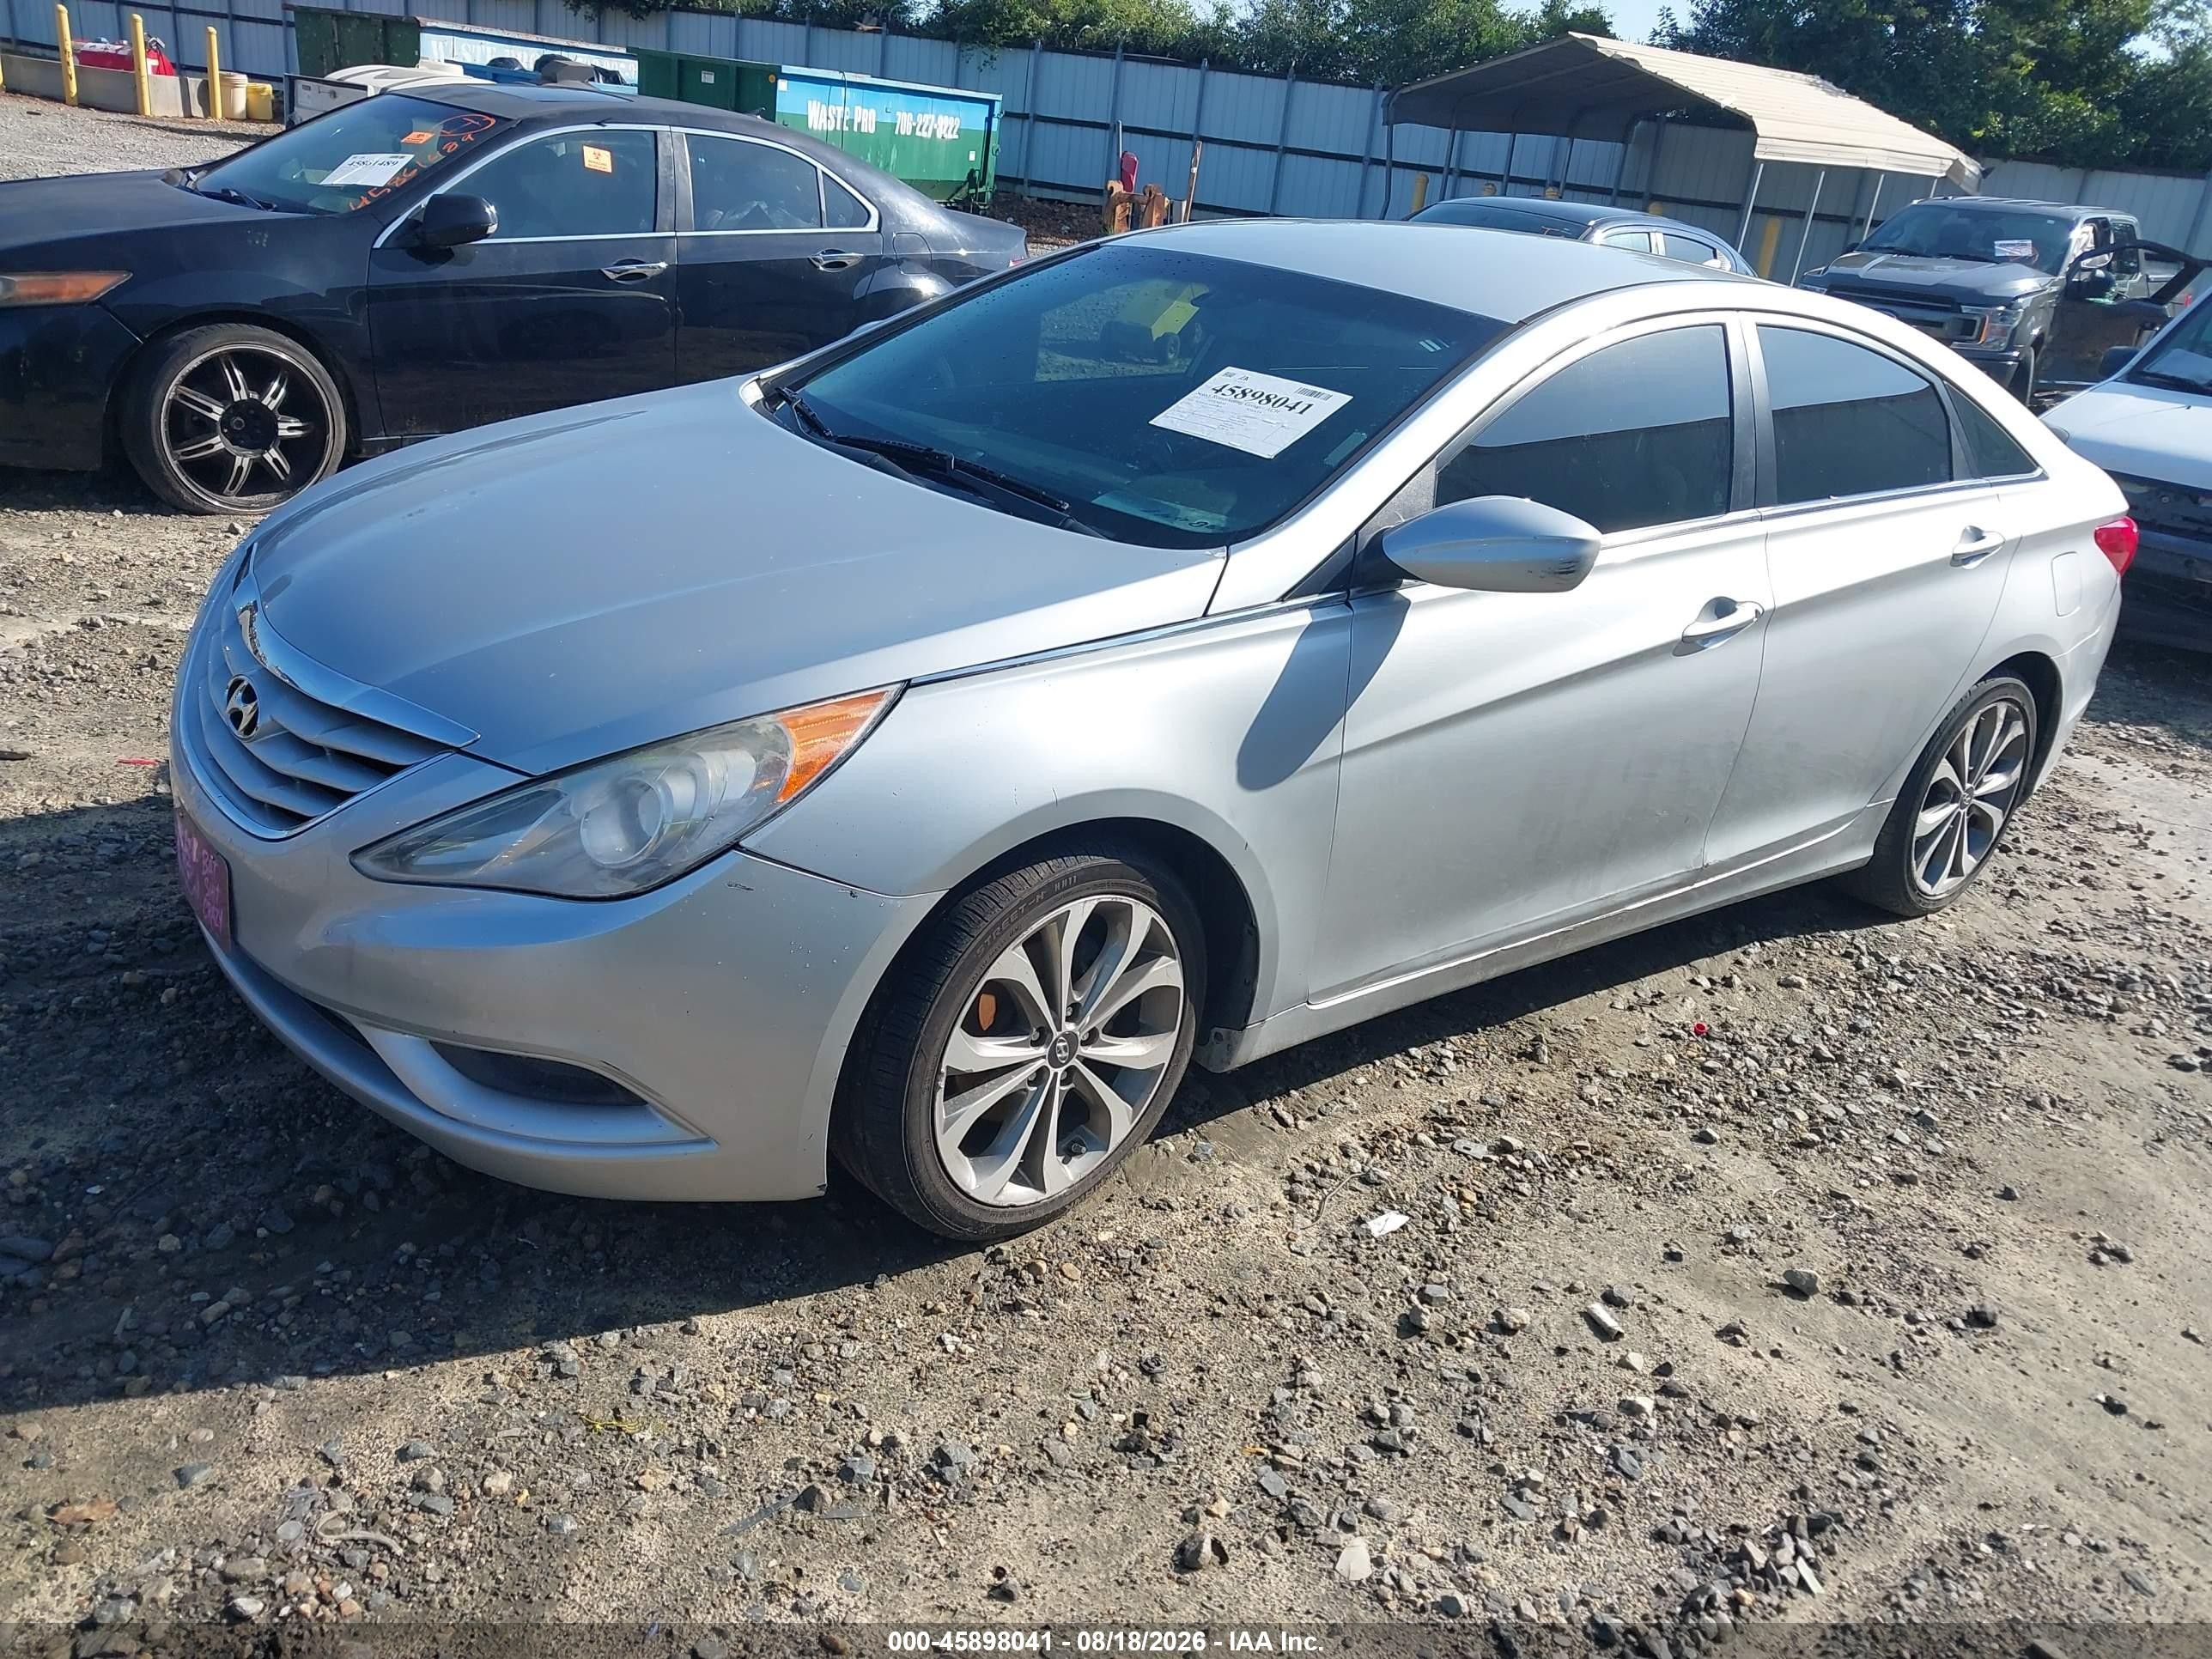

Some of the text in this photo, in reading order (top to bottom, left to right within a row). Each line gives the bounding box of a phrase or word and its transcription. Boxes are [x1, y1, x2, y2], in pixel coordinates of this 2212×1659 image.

[807, 100, 849, 131] WASTE
[854, 106, 876, 134] PRO
[1212, 383, 1314, 415] 45898041
